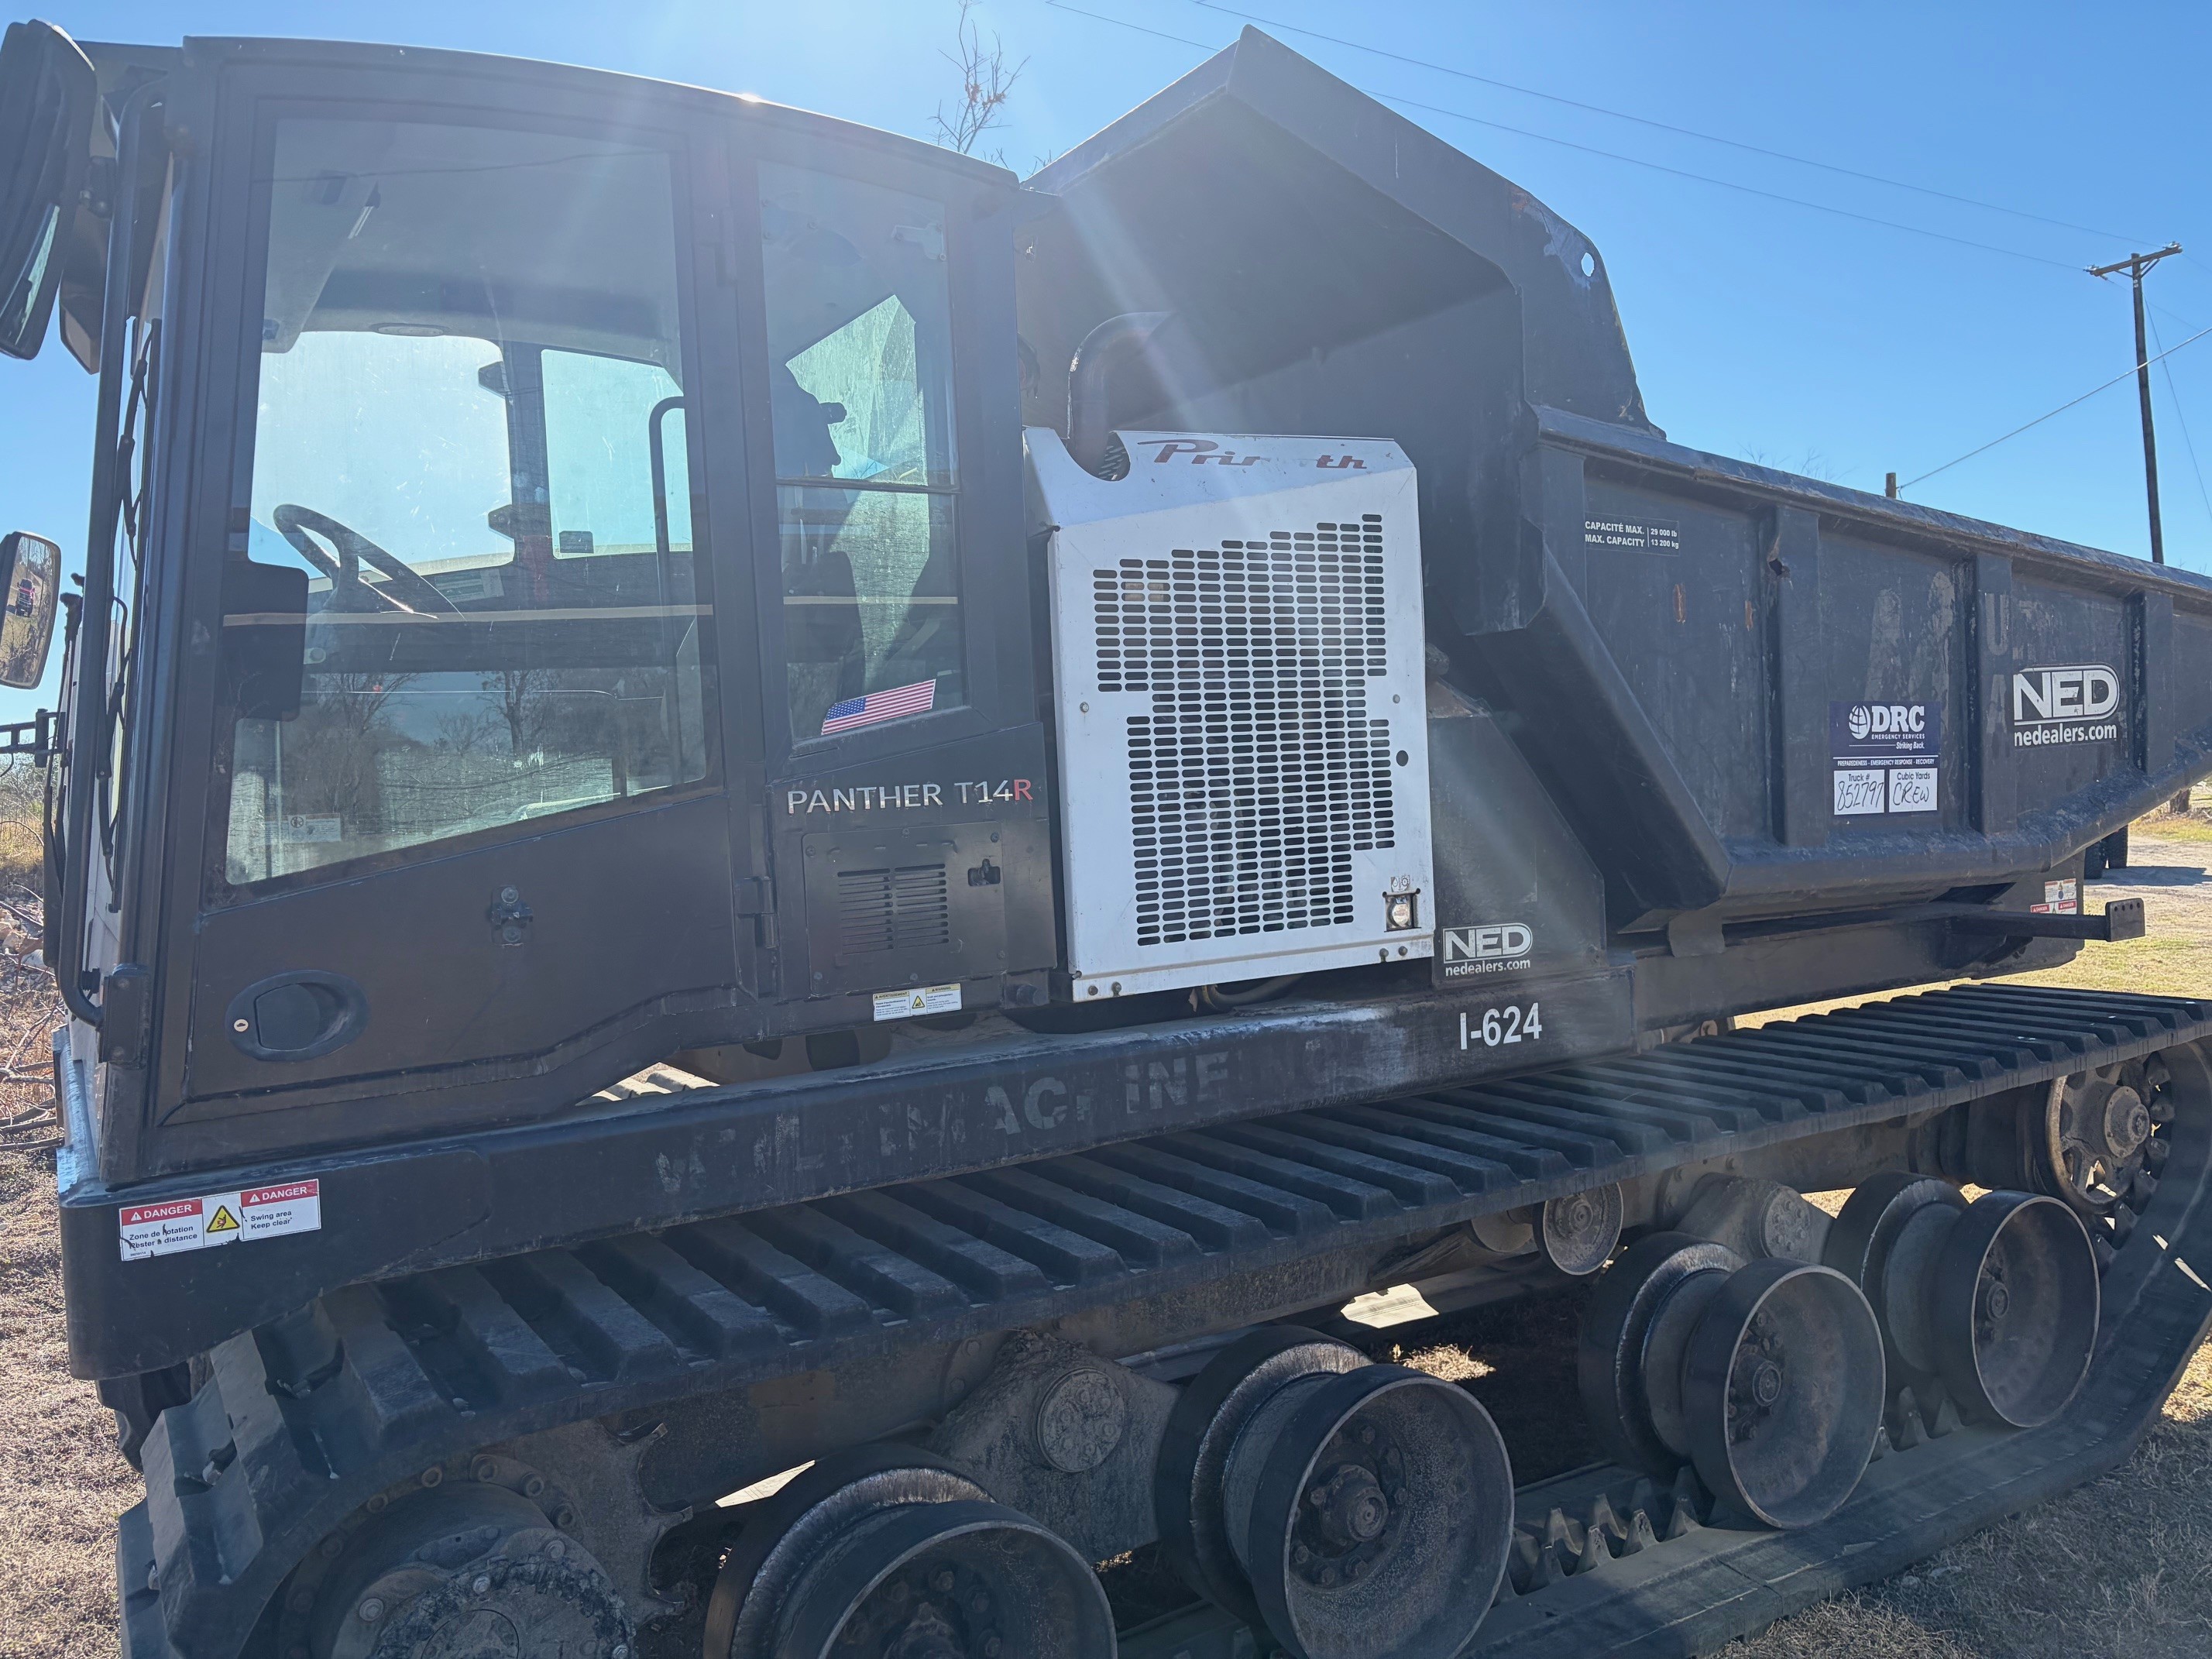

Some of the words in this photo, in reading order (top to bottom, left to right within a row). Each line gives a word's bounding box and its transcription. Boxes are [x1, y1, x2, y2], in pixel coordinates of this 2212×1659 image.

[1138, 438, 1367, 469] Prith
[1585, 520, 1623, 533] CAPACITÉ
[1626, 524, 1644, 534] MAX.
[1585, 534, 1605, 544] MAX.
[1606, 535, 1645, 548] CAPACITY
[1671, 541, 1679, 550] kg
[2013, 670, 2118, 720] NED
[1871, 706, 1925, 733] DRC
[2014, 723, 2118, 747] nedealers.com
[1896, 741, 1913, 750] Striking
[1897, 772, 1914, 781] Cubic
[786, 783, 943, 814] PANTHER
[954, 778, 1034, 804] T14R
[1892, 781, 1929, 805] CREW
[1444, 926, 1531, 960] NED
[1445, 959, 1531, 977] nedealers.com
[1459, 1002, 1543, 1050] I-624
[262, 1186, 307, 1200] DANGER
[143, 1204, 192, 1219] DANGER
[250, 1213, 274, 1221] Swing
[164, 1234, 198, 1244] distance
